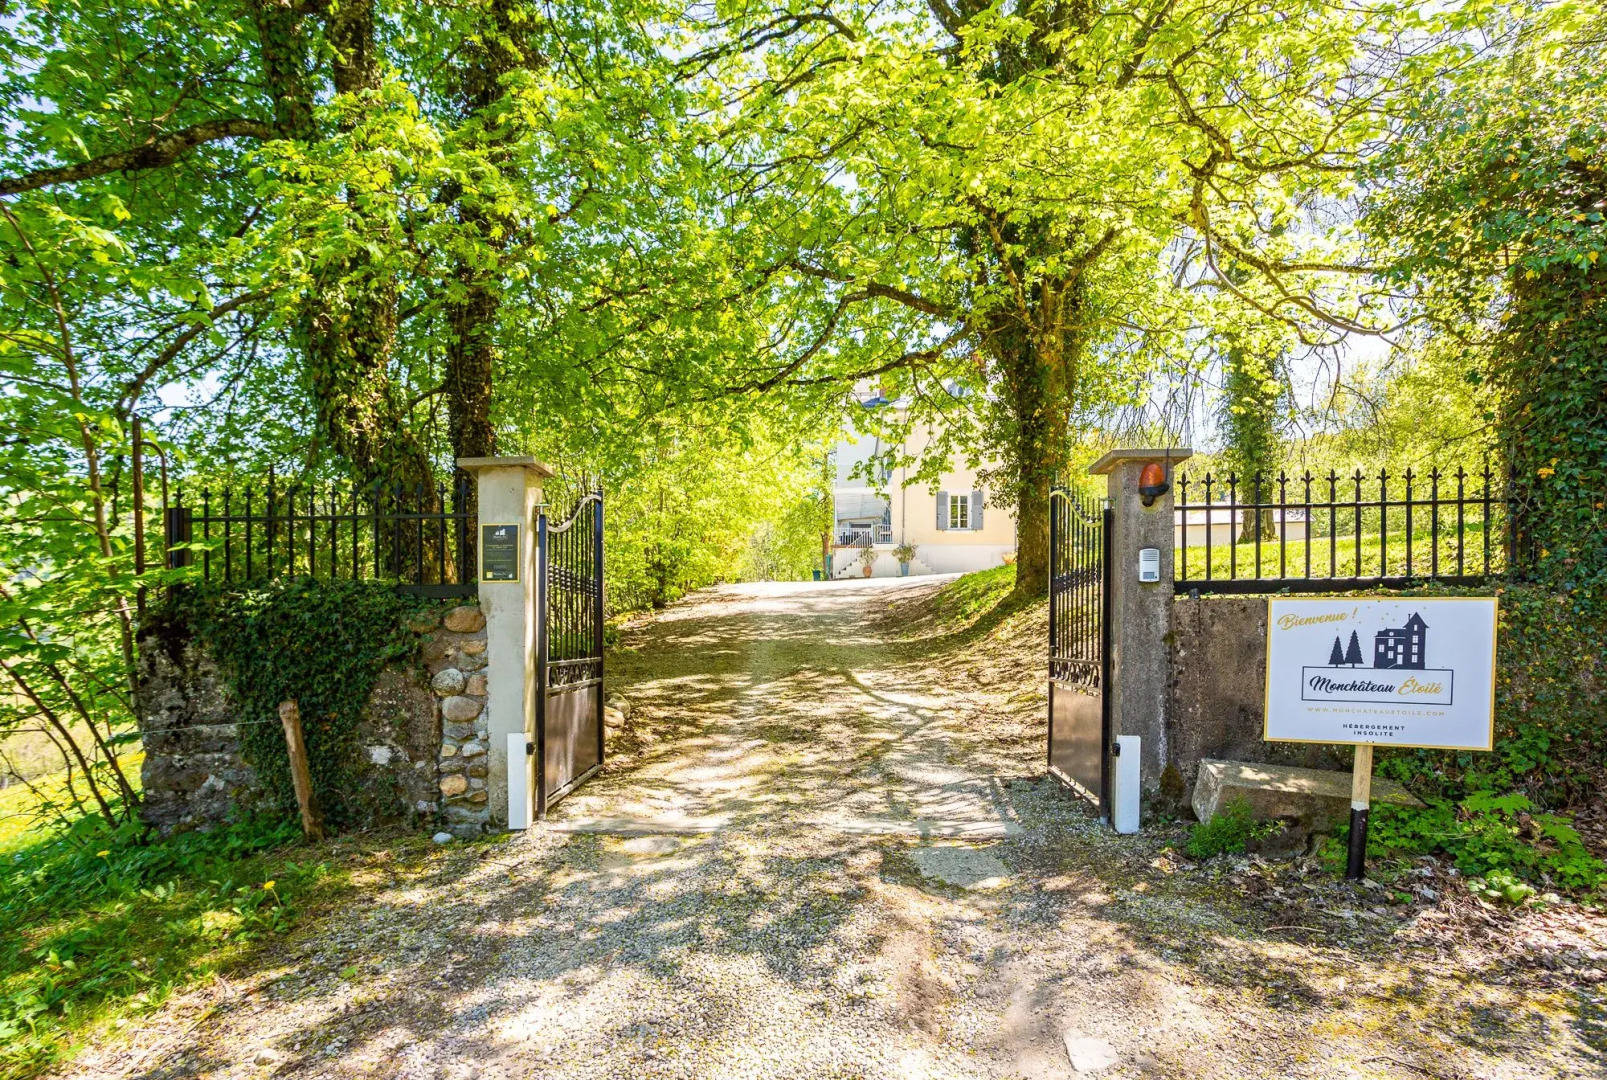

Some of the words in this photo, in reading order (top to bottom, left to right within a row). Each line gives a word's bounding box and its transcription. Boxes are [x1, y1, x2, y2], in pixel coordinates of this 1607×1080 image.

[1277, 612, 1347, 631] Bienvenue
[1352, 607, 1358, 619] !
[1309, 675, 1395, 693] Monchâteau
[1398, 676, 1443, 696] Étoilé
[1306, 706, 1445, 716] WWW.MONCHATEAUETOILE.COM
[1342, 723, 1405, 731] HÉBERGEMENT
